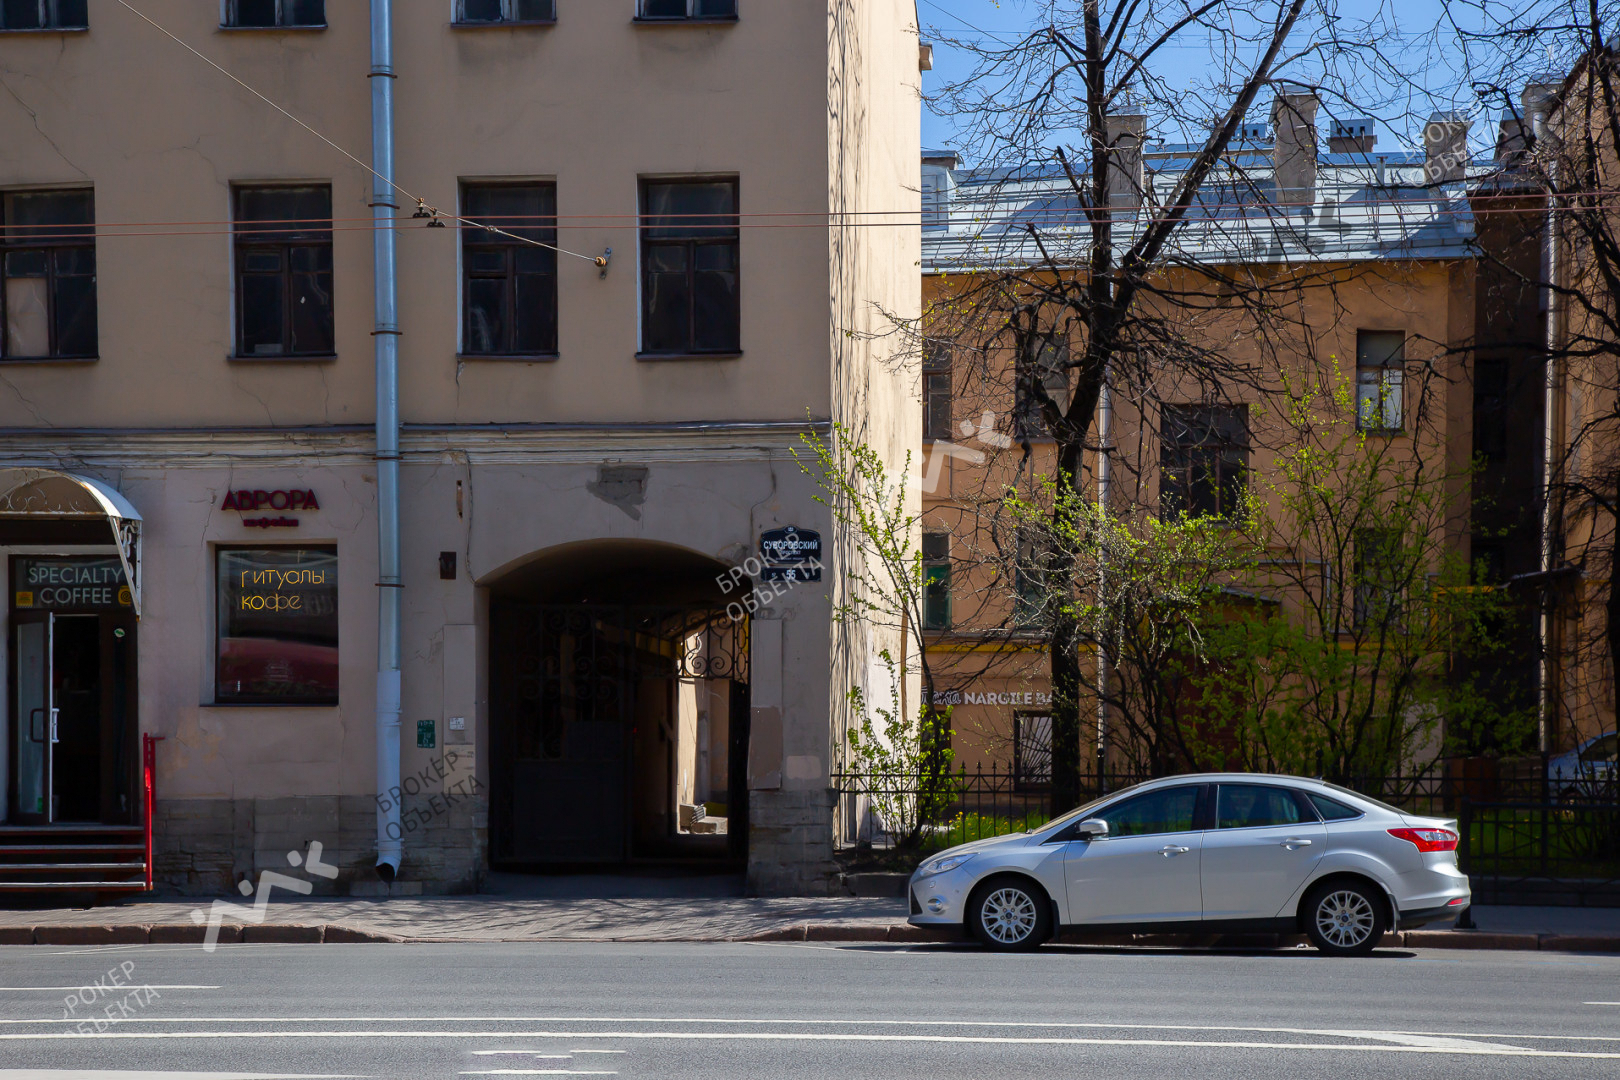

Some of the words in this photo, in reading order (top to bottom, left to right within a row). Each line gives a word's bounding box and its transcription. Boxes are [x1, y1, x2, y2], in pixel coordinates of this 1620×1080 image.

[221, 488, 320, 511] АВРОРА
[763, 540, 818, 550] СУВОРОВСКИЙ
[28, 567, 123, 583] SPECIALTY
[786, 569, 797, 580] 55
[40, 587, 112, 604] COFFEE
[241, 593, 302, 612] кофе
[964, 692, 1032, 705] NARGILE
